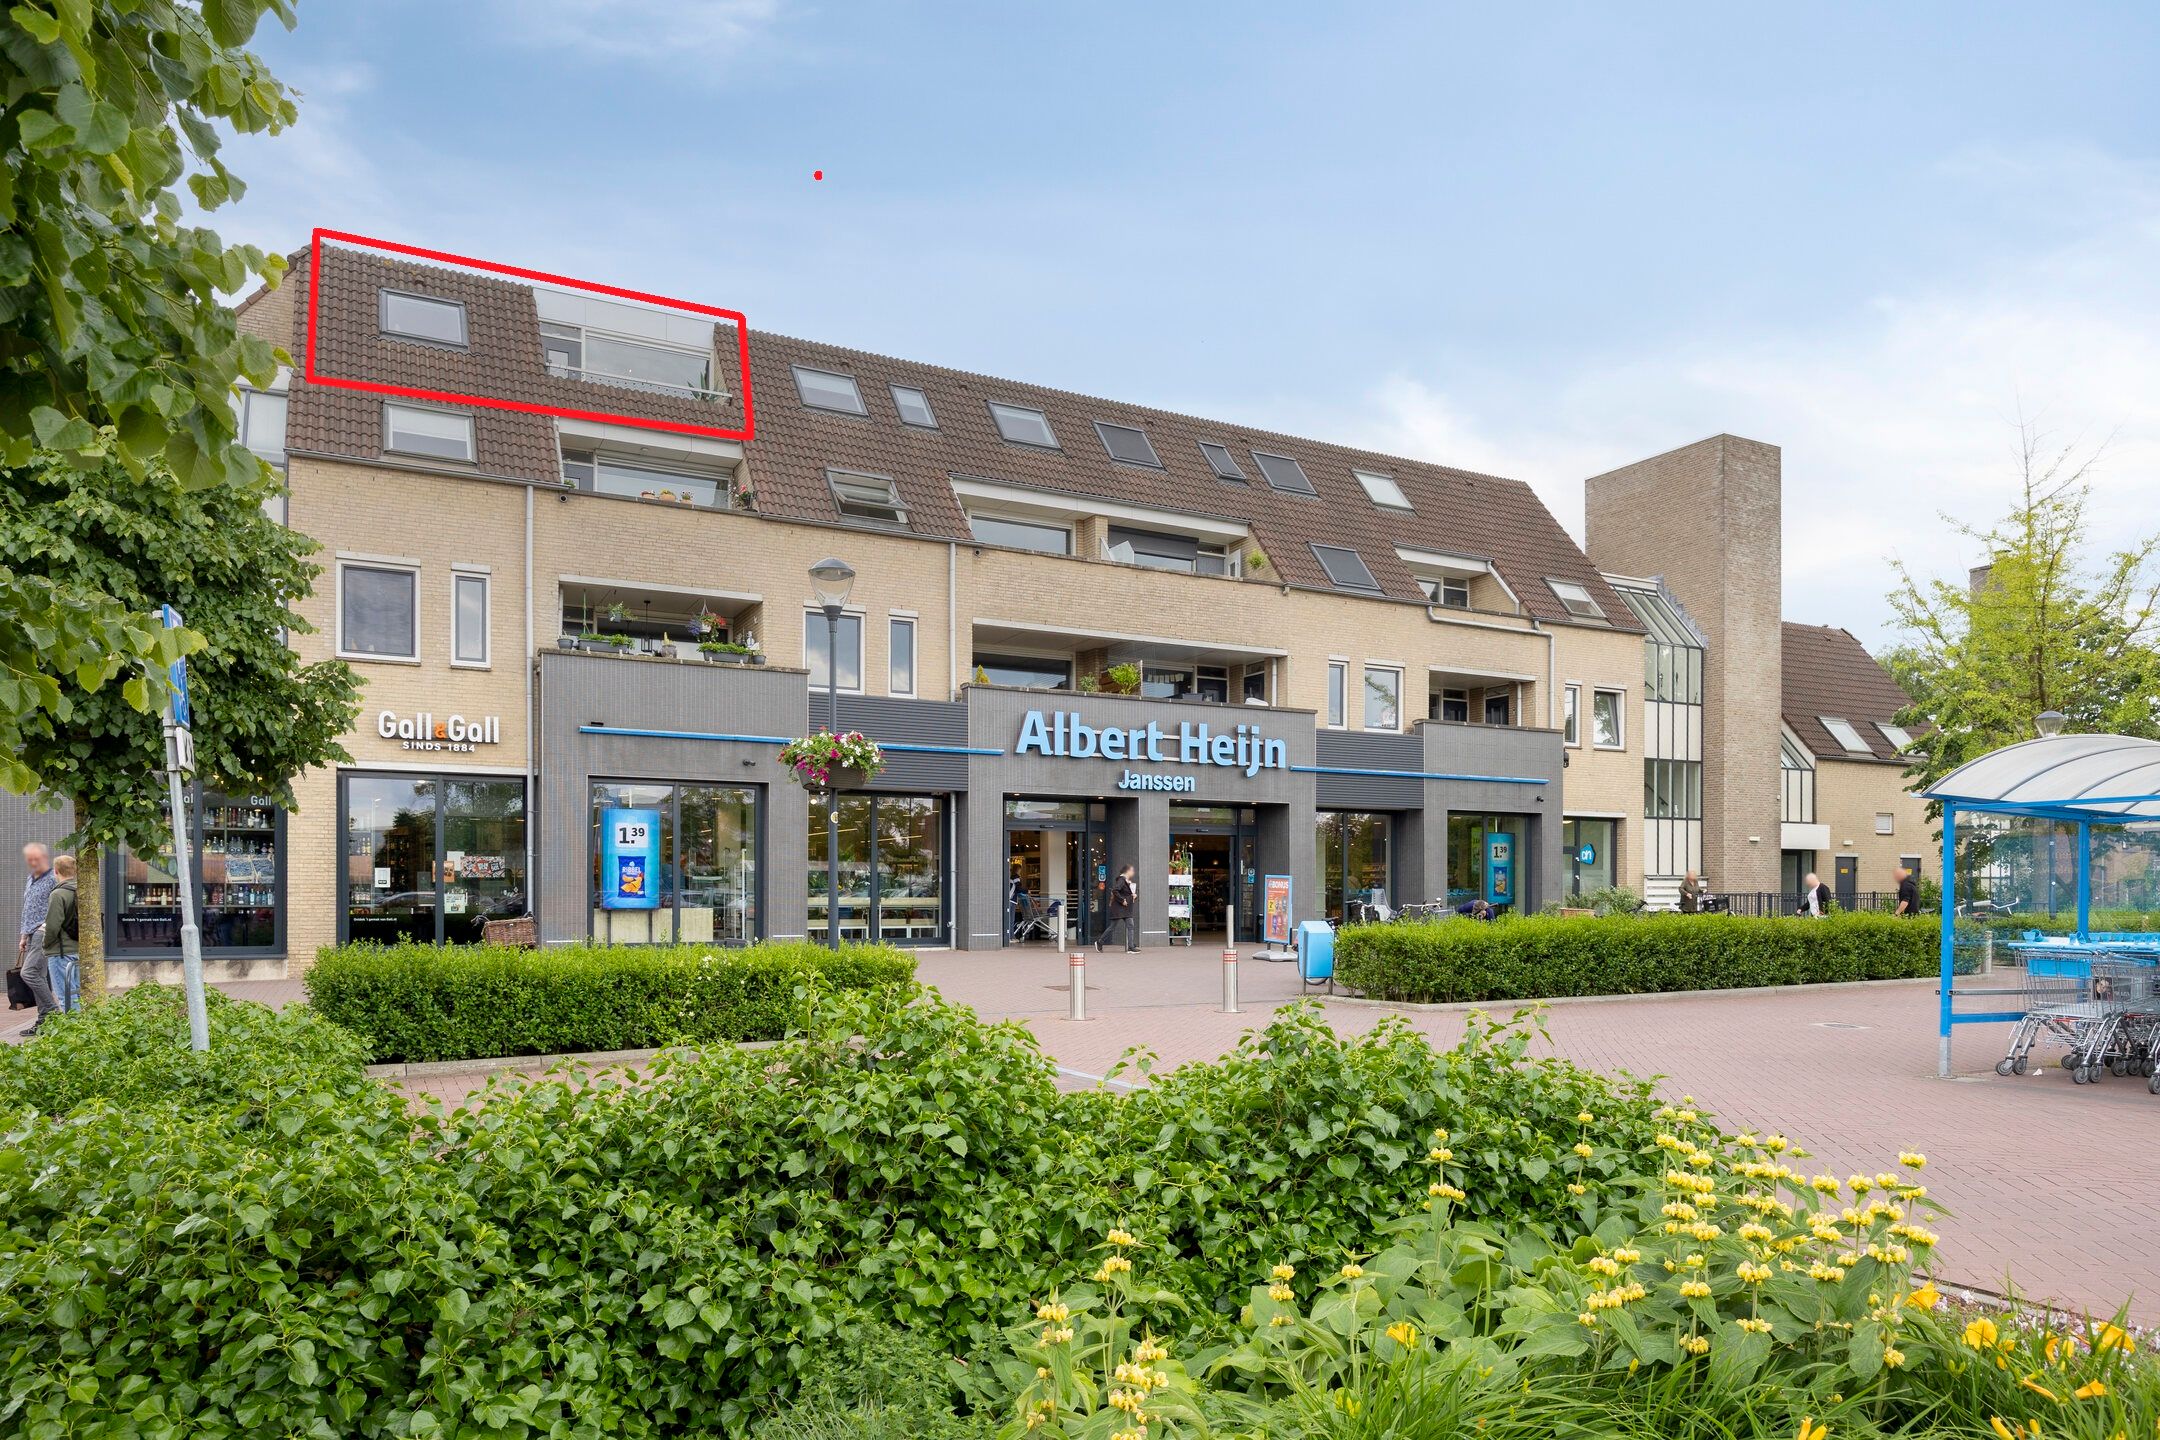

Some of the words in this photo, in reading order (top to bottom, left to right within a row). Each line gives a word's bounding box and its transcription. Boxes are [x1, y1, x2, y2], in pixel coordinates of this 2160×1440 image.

[402, 741, 442, 751] SINDS
[447, 743, 476, 752] 1884
[1015, 710, 1164, 762] Albert
[1180, 721, 1287, 777] Heijn
[1117, 769, 1196, 792] Janssen
[250, 795, 272, 806] Gall
[619, 827, 646, 845] 1.39
